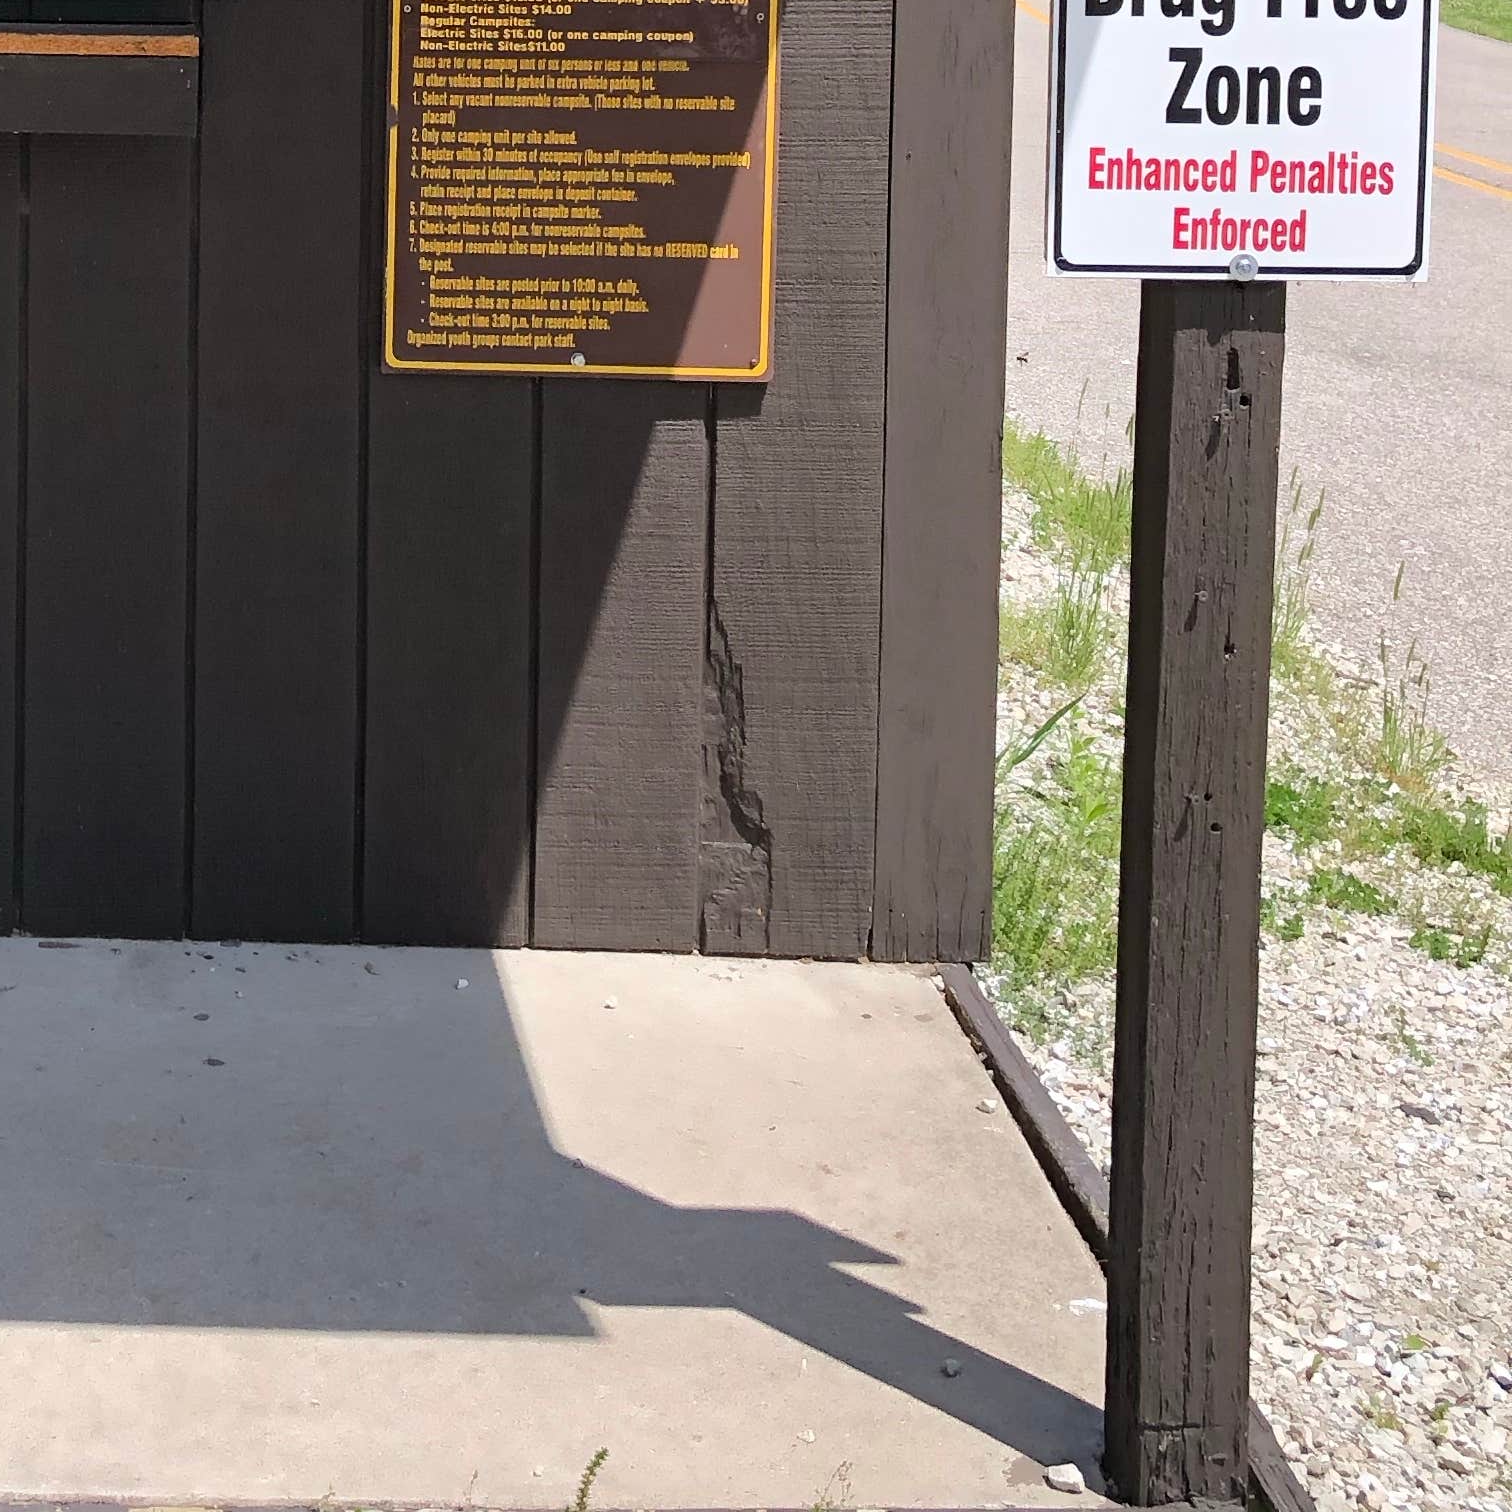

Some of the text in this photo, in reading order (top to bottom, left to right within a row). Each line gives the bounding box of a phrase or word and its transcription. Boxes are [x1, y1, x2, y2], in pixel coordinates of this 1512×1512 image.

[420, 28, 465, 41] Electric
[469, 28, 499, 42] Sites
[547, 29, 563, 42] (or
[566, 31, 588, 39] one
[592, 29, 642, 42] camping
[1165, 48, 1323, 127] Zone
[1089, 147, 1395, 196] Enhanced Penalties
[1172, 208, 1307, 253] Enforced
